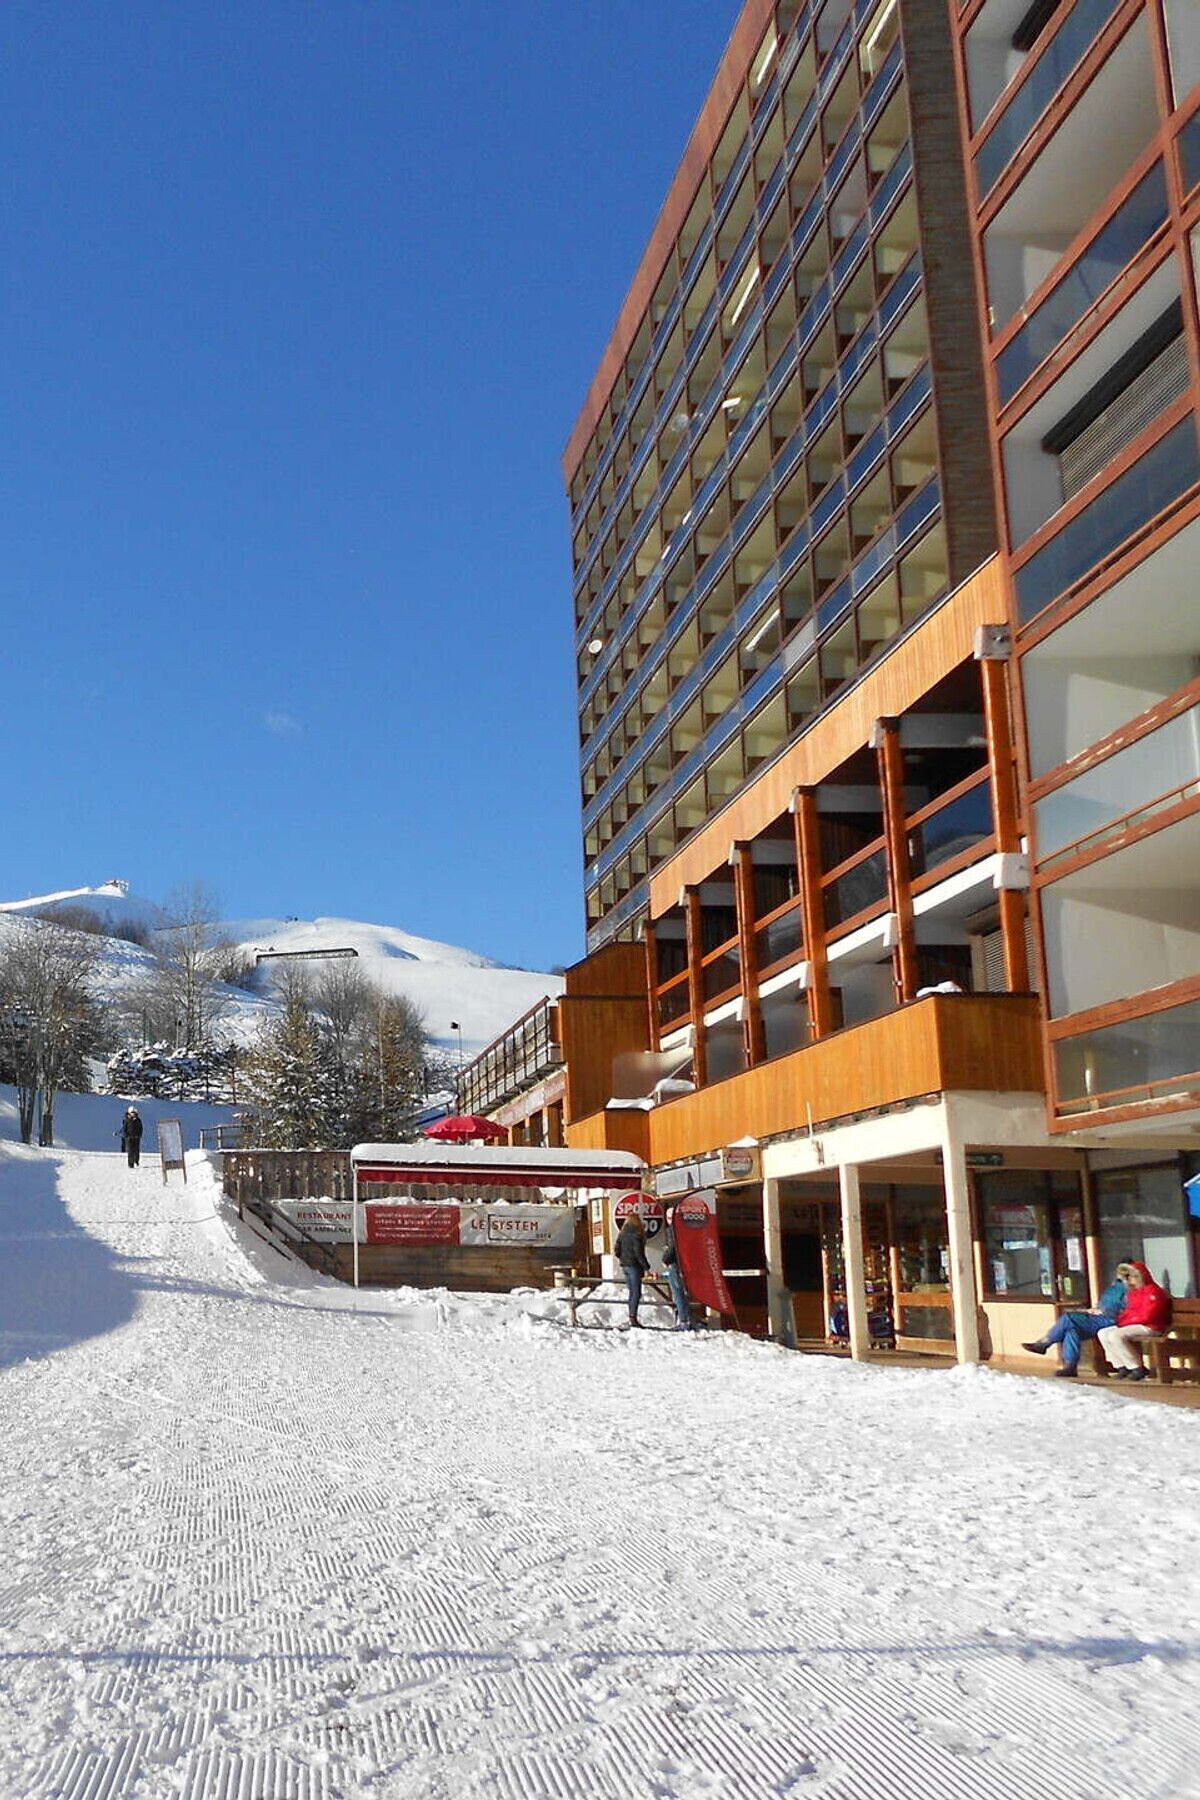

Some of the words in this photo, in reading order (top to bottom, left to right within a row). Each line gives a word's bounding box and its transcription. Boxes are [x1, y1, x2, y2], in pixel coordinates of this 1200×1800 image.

[616, 1203, 657, 1215] SPORT
[682, 1212, 707, 1221] 2000
[471, 1219, 486, 1230] LE
[492, 1220, 539, 1231] SYSTEM
